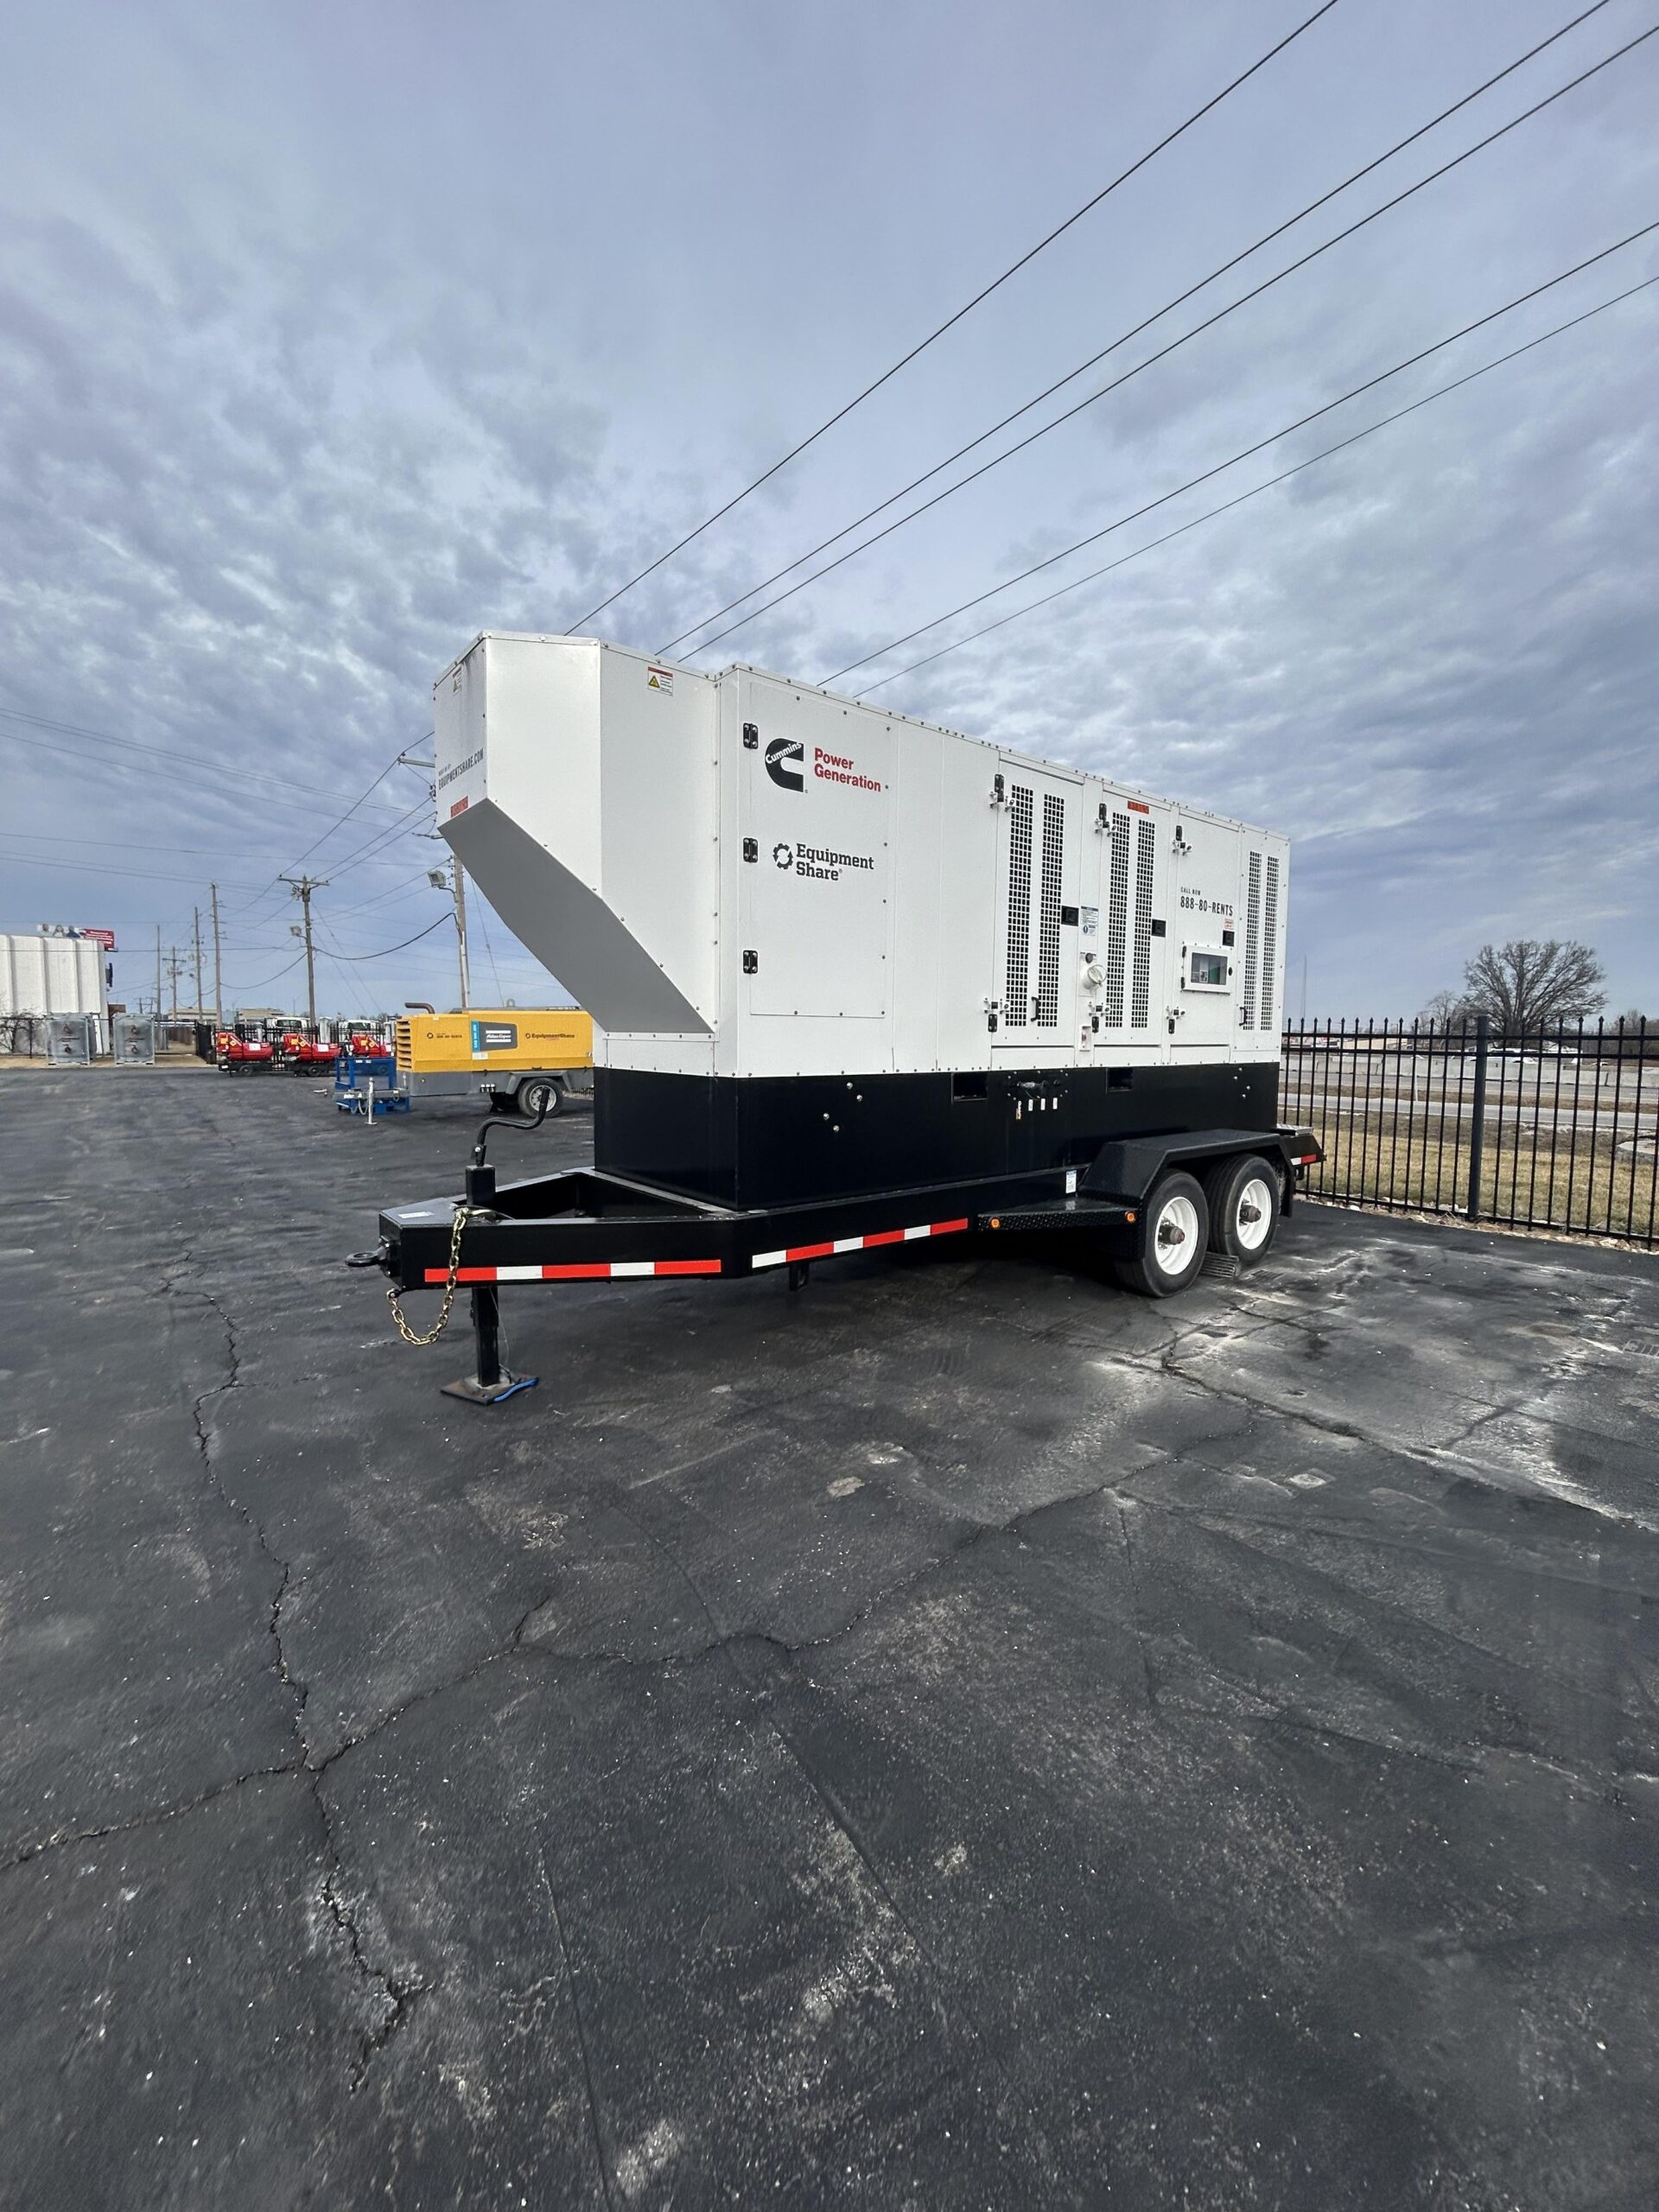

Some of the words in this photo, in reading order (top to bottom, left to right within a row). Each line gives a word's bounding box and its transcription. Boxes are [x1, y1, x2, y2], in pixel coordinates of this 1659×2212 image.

[766, 742, 802, 764] Cummins
[814, 747, 854, 770] Power
[438, 747, 484, 790] EQUIPMENTSHARE.COM
[814, 763, 881, 792] Generation
[796, 843, 874, 870] Equipment
[796, 861, 839, 881] Share
[1180, 895, 1233, 917] 888-80-RENTS
